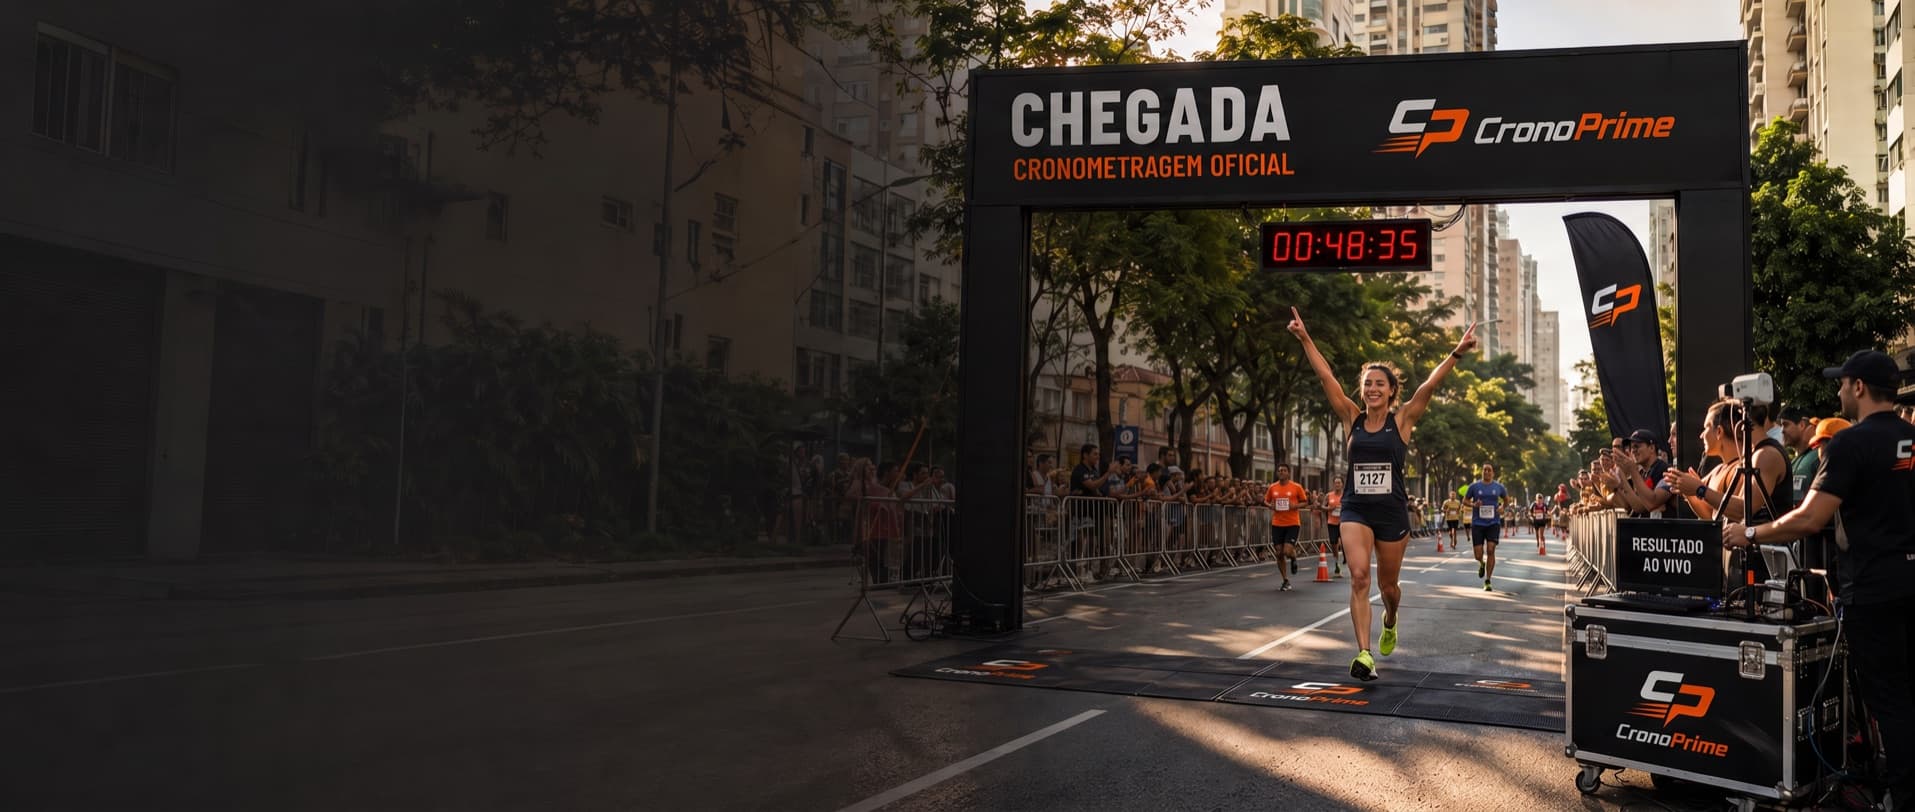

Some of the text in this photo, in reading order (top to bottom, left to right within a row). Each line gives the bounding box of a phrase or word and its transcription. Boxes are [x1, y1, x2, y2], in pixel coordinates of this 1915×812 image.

[1011, 84, 1291, 147] CHEGADA
[1474, 111, 1676, 144] CronoPrime
[1013, 152, 1295, 181] CRONOMETRAGEM OFICIAL
[1273, 229, 1417, 262] 00:48:35
[1360, 472, 1385, 485] 2127
[1632, 537, 1704, 555] RESULTADO
[1643, 558, 1692, 575] AO VIVO
[1616, 723, 1729, 758] CronoPrime
